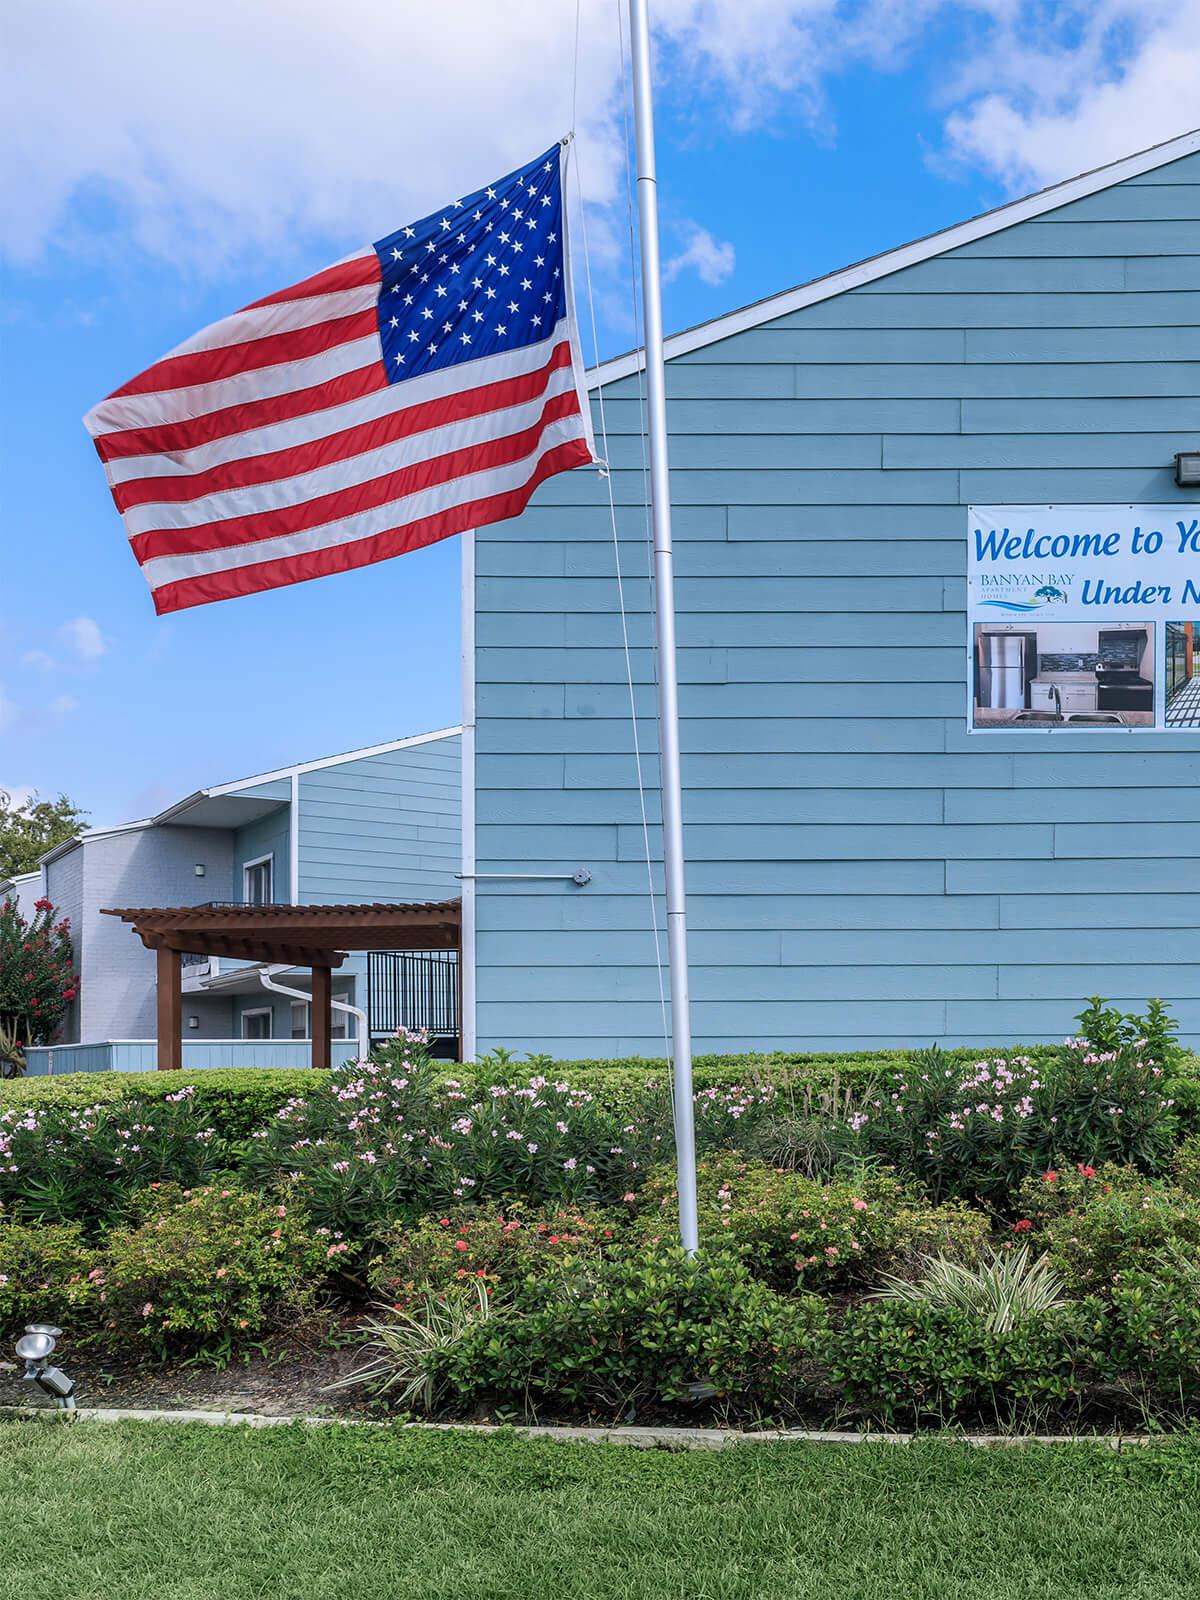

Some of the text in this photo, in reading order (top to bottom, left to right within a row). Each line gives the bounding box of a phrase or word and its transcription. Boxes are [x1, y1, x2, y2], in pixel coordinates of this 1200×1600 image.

[974, 527, 1121, 562] Welcome
[1131, 526, 1164, 555] to
[981, 573, 1075, 586] BANYAN BAY
[1081, 579, 1172, 605] Under
